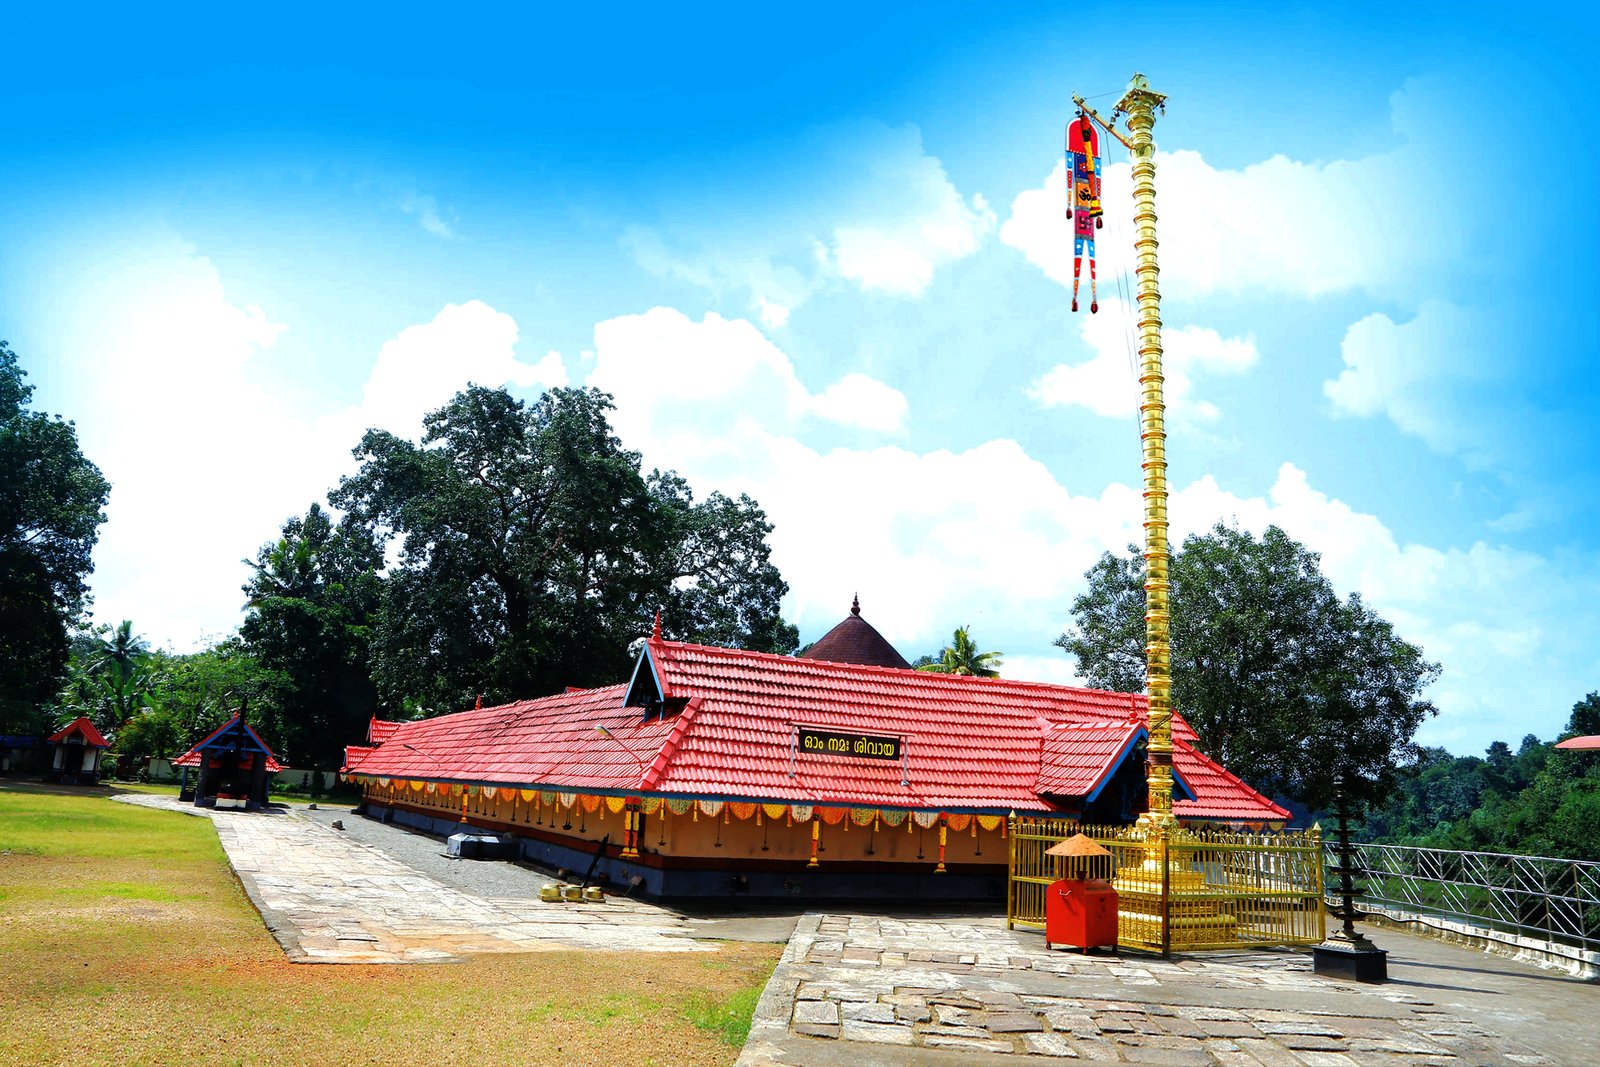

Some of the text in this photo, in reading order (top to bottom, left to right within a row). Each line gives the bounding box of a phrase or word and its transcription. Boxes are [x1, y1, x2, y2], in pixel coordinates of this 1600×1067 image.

[804, 735, 895, 756] ഓം നമഃ ശിവായ
